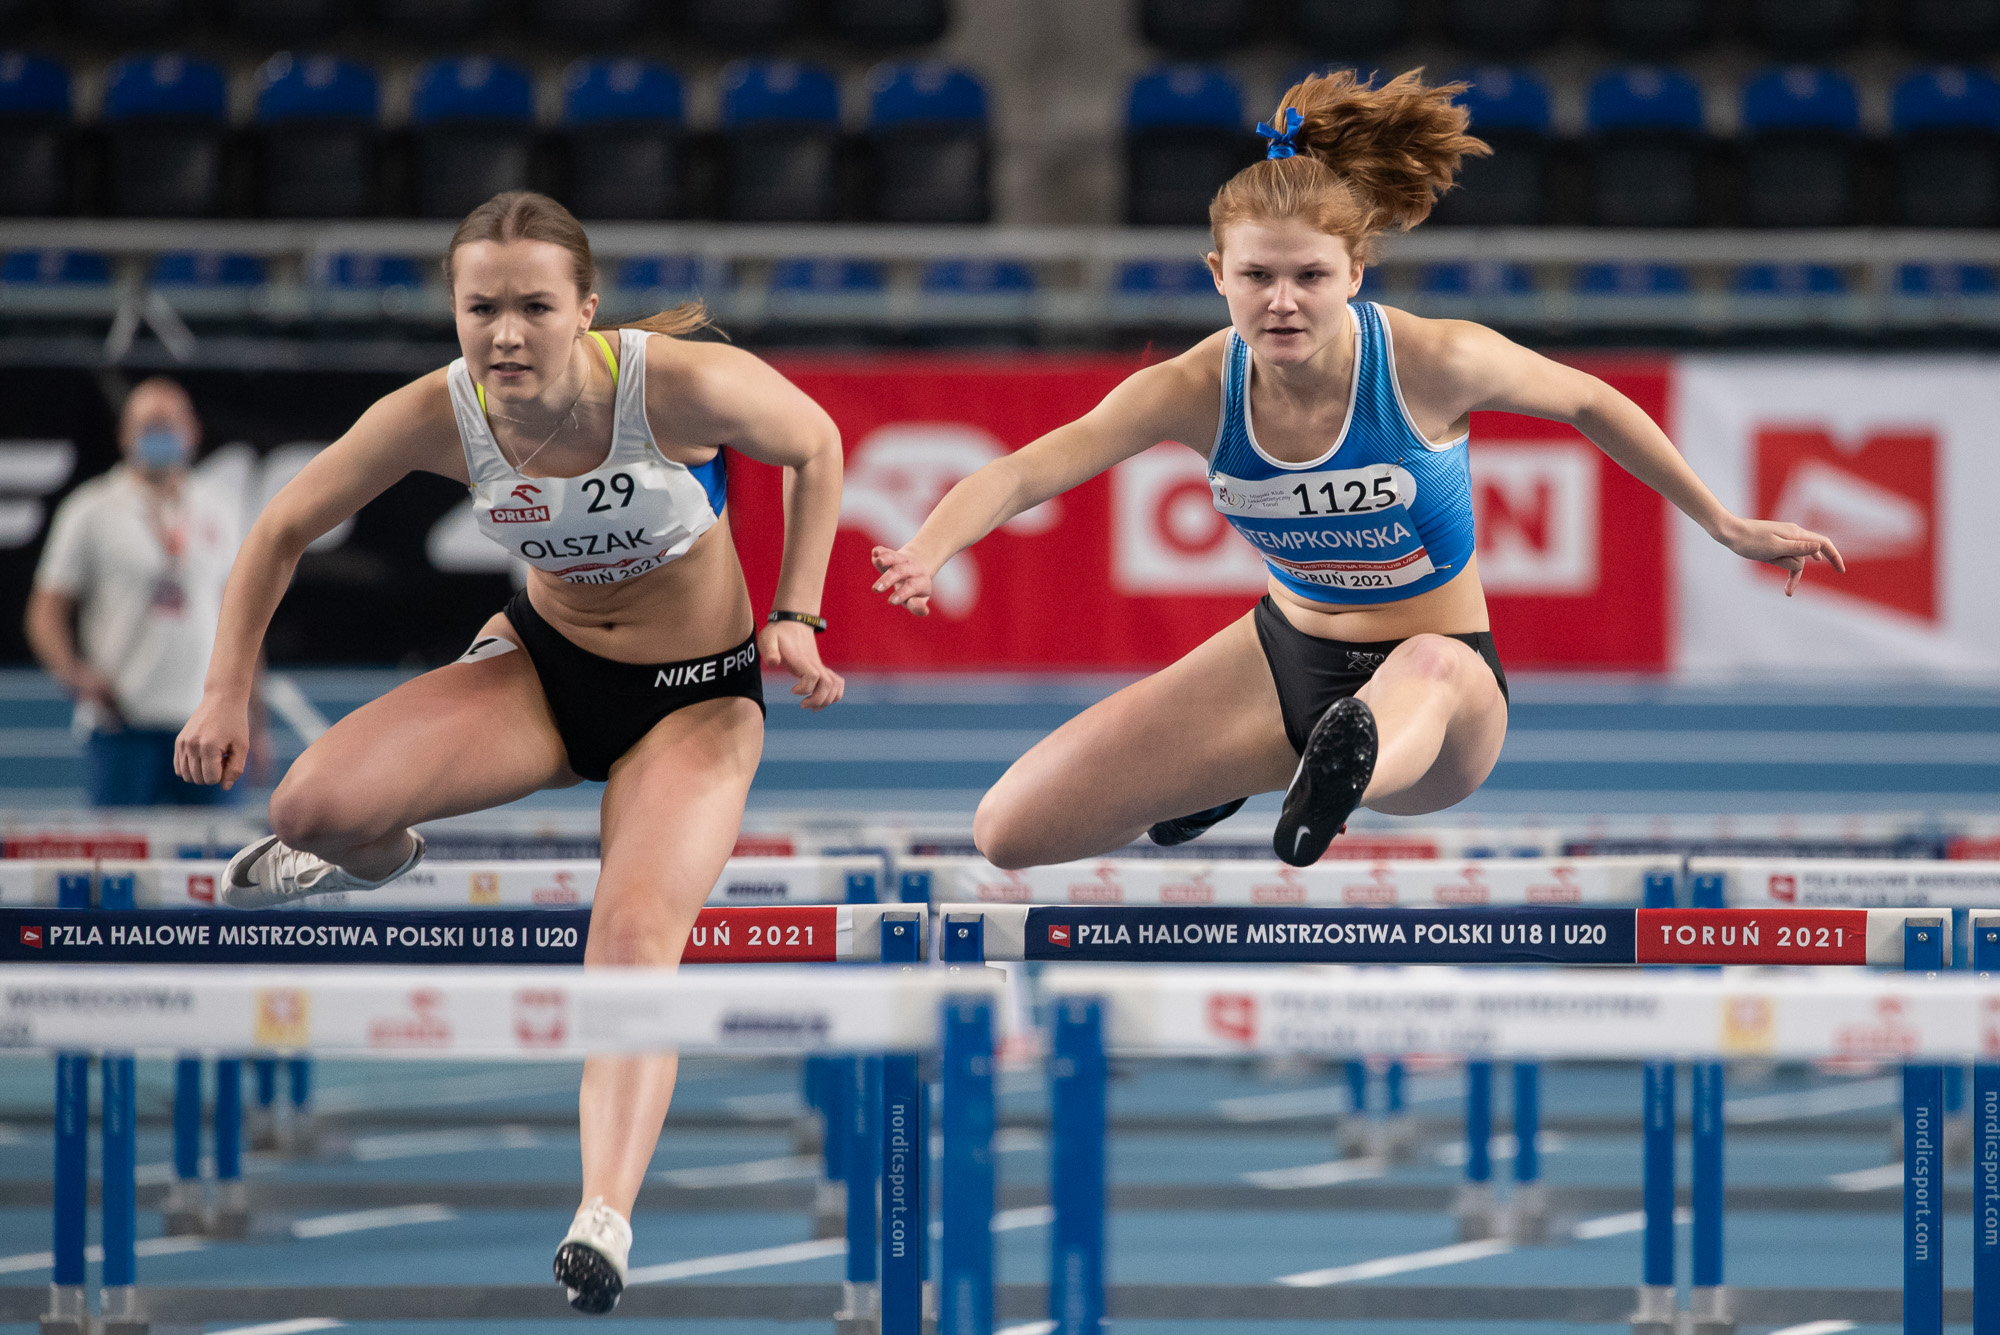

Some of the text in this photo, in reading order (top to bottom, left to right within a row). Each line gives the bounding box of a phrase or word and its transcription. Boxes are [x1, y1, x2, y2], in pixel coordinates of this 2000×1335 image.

[581, 473, 635, 514] 29
[1292, 476, 1397, 515] 1125
[494, 508, 547, 522] ORLEN
[520, 528, 652, 559] OLSZAK
[619, 555, 662, 579] 2021
[1285, 568, 1393, 587] TORUŃ 2021
[654, 642, 755, 687] NIKE PRO
[50, 925, 578, 948] PZLA HALOWE MISTRZOSTWA POLSKI U18 I U20
[747, 925, 813, 946] 2021
[1078, 924, 1607, 945] PZLA HALOWE MISTRZOSTWA POLSKI U18 I U20
[1661, 920, 1843, 948] TORUŃ 2021
[888, 1104, 909, 1258] nordicsport.com
[1981, 1091, 2000, 1246] nordicsport.com
[1912, 1107, 1933, 1261] nordicsport.com
